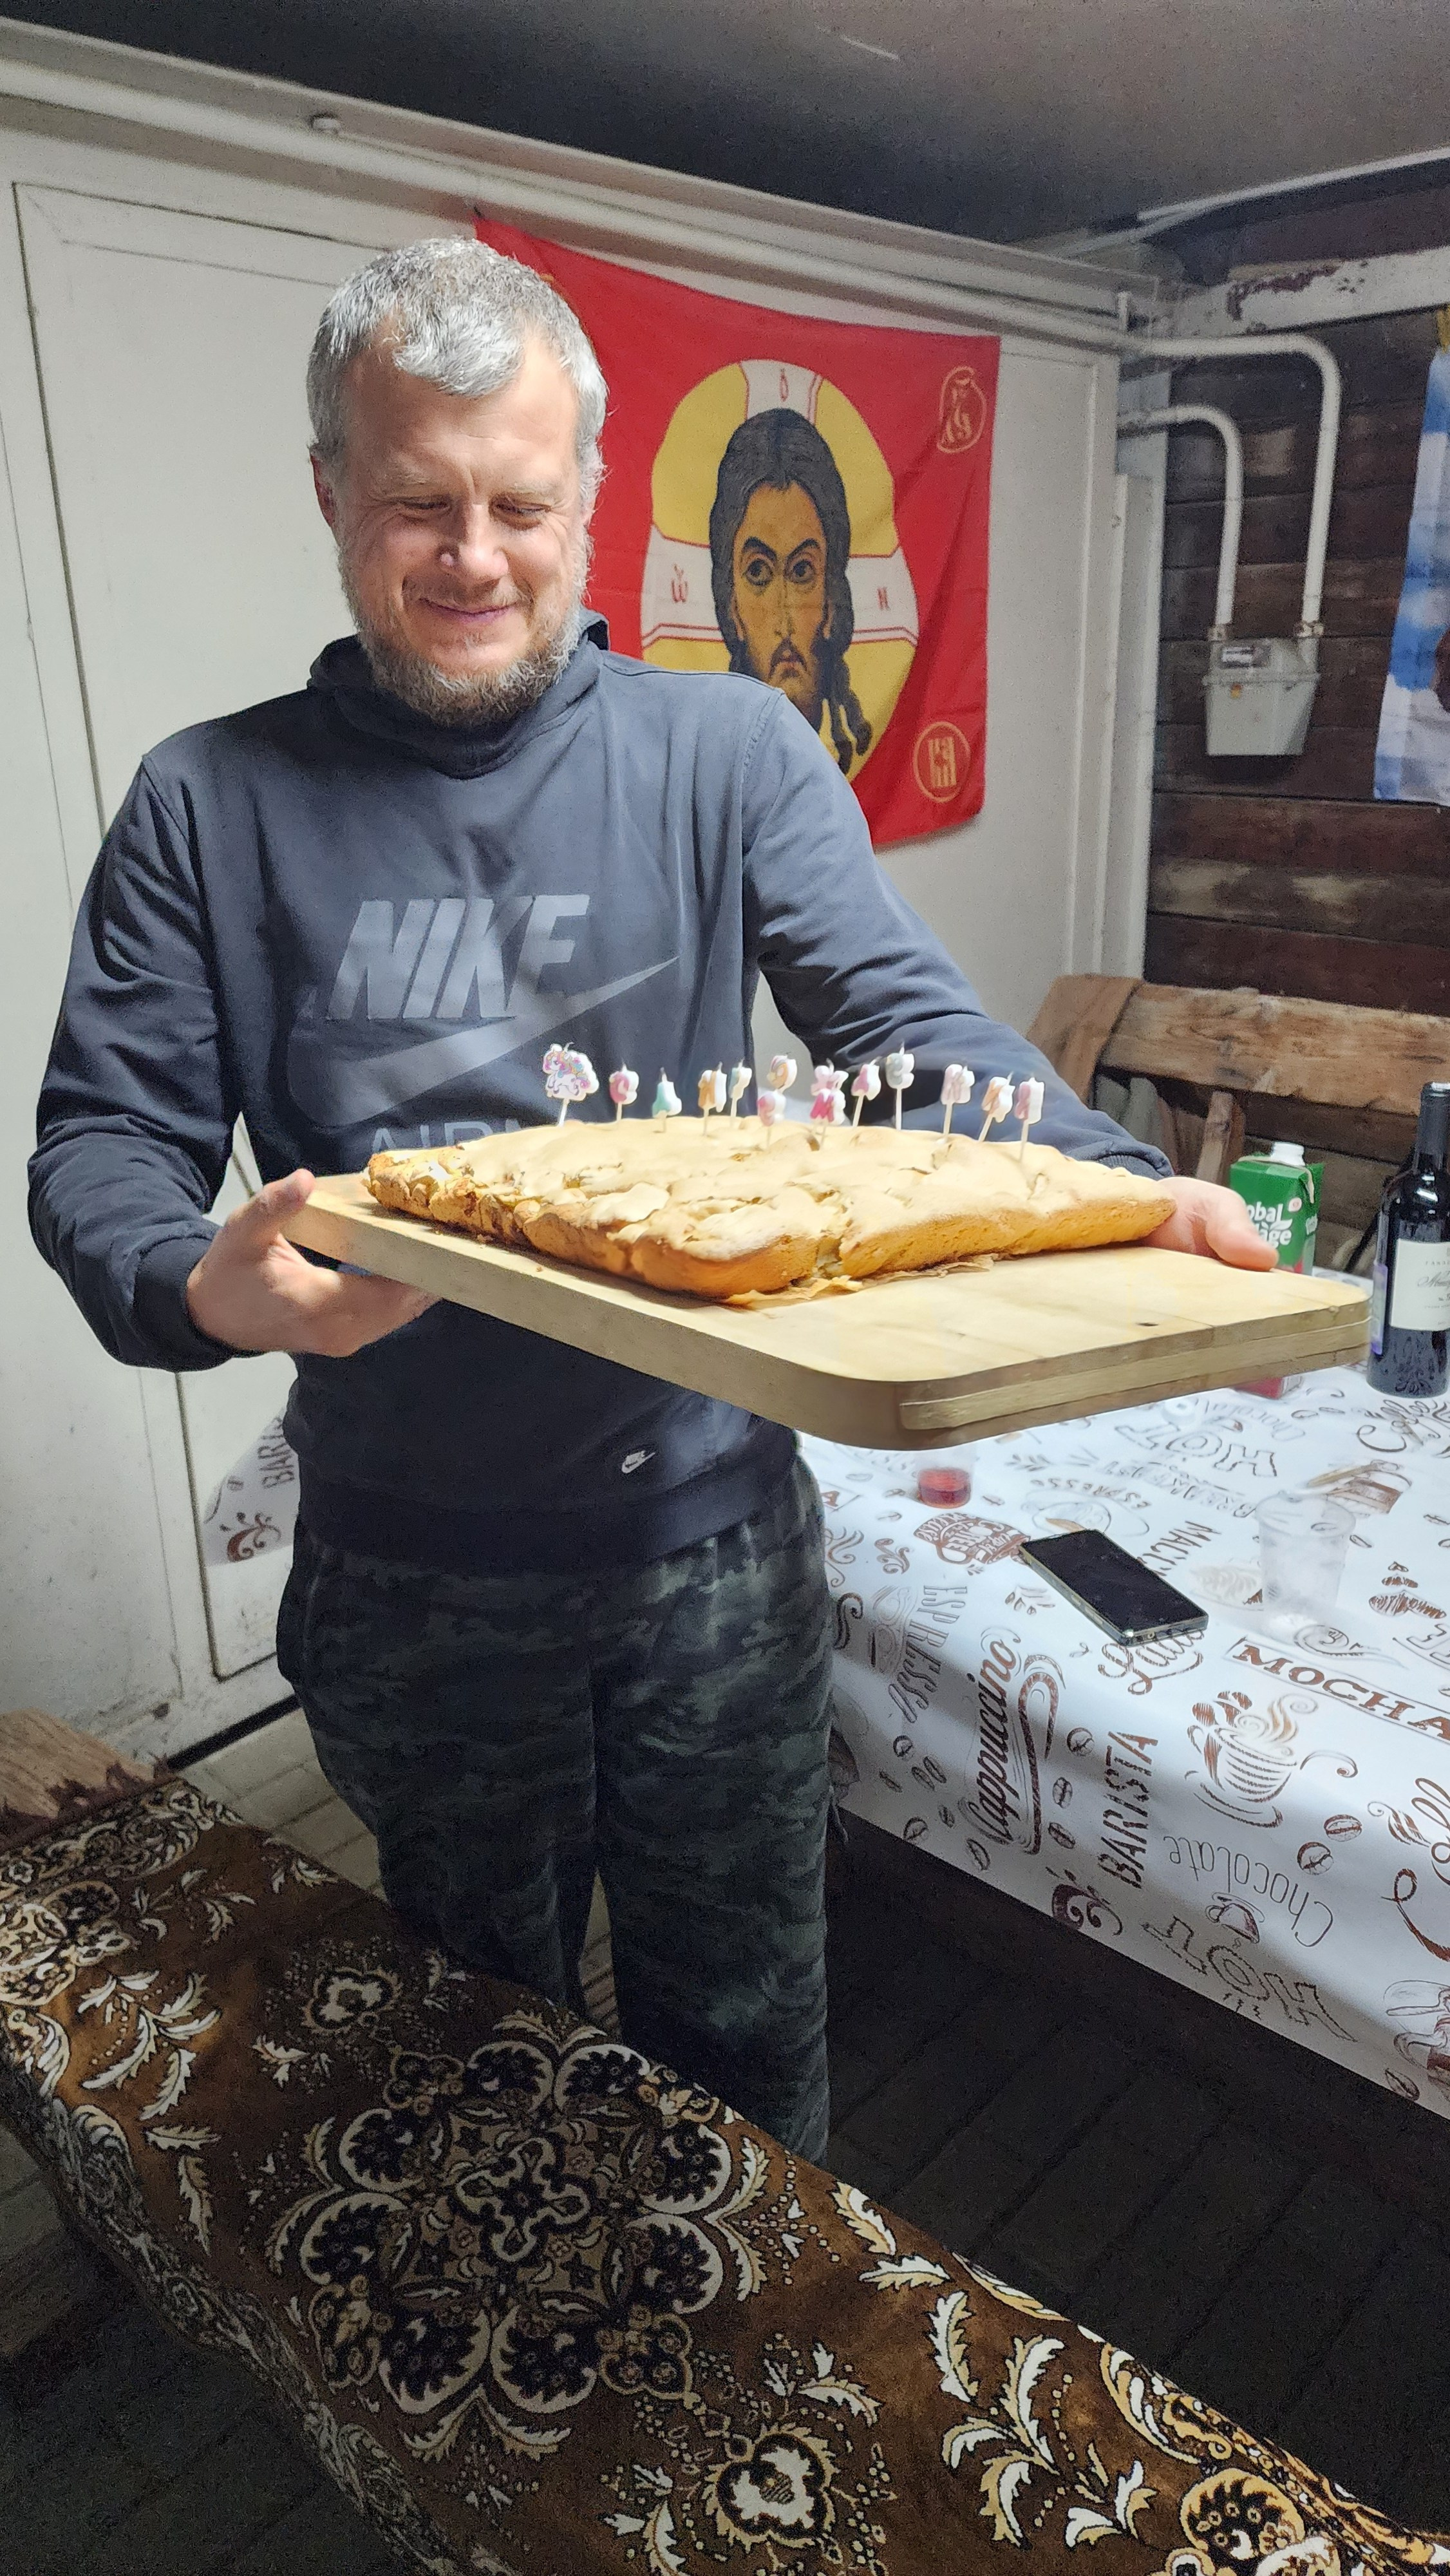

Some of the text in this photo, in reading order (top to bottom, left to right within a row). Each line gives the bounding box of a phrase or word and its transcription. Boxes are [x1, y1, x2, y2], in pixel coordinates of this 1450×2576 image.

[328, 895, 590, 1019] NIKE
[888, 1585, 968, 1723] ESPRESSO
[1232, 1644, 1450, 1740] MOCHA
[959, 1639, 1034, 1845] Cappuccino
[1098, 1730, 1158, 1889] BARISTA
[1163, 1836, 1333, 1947] Chocolate
